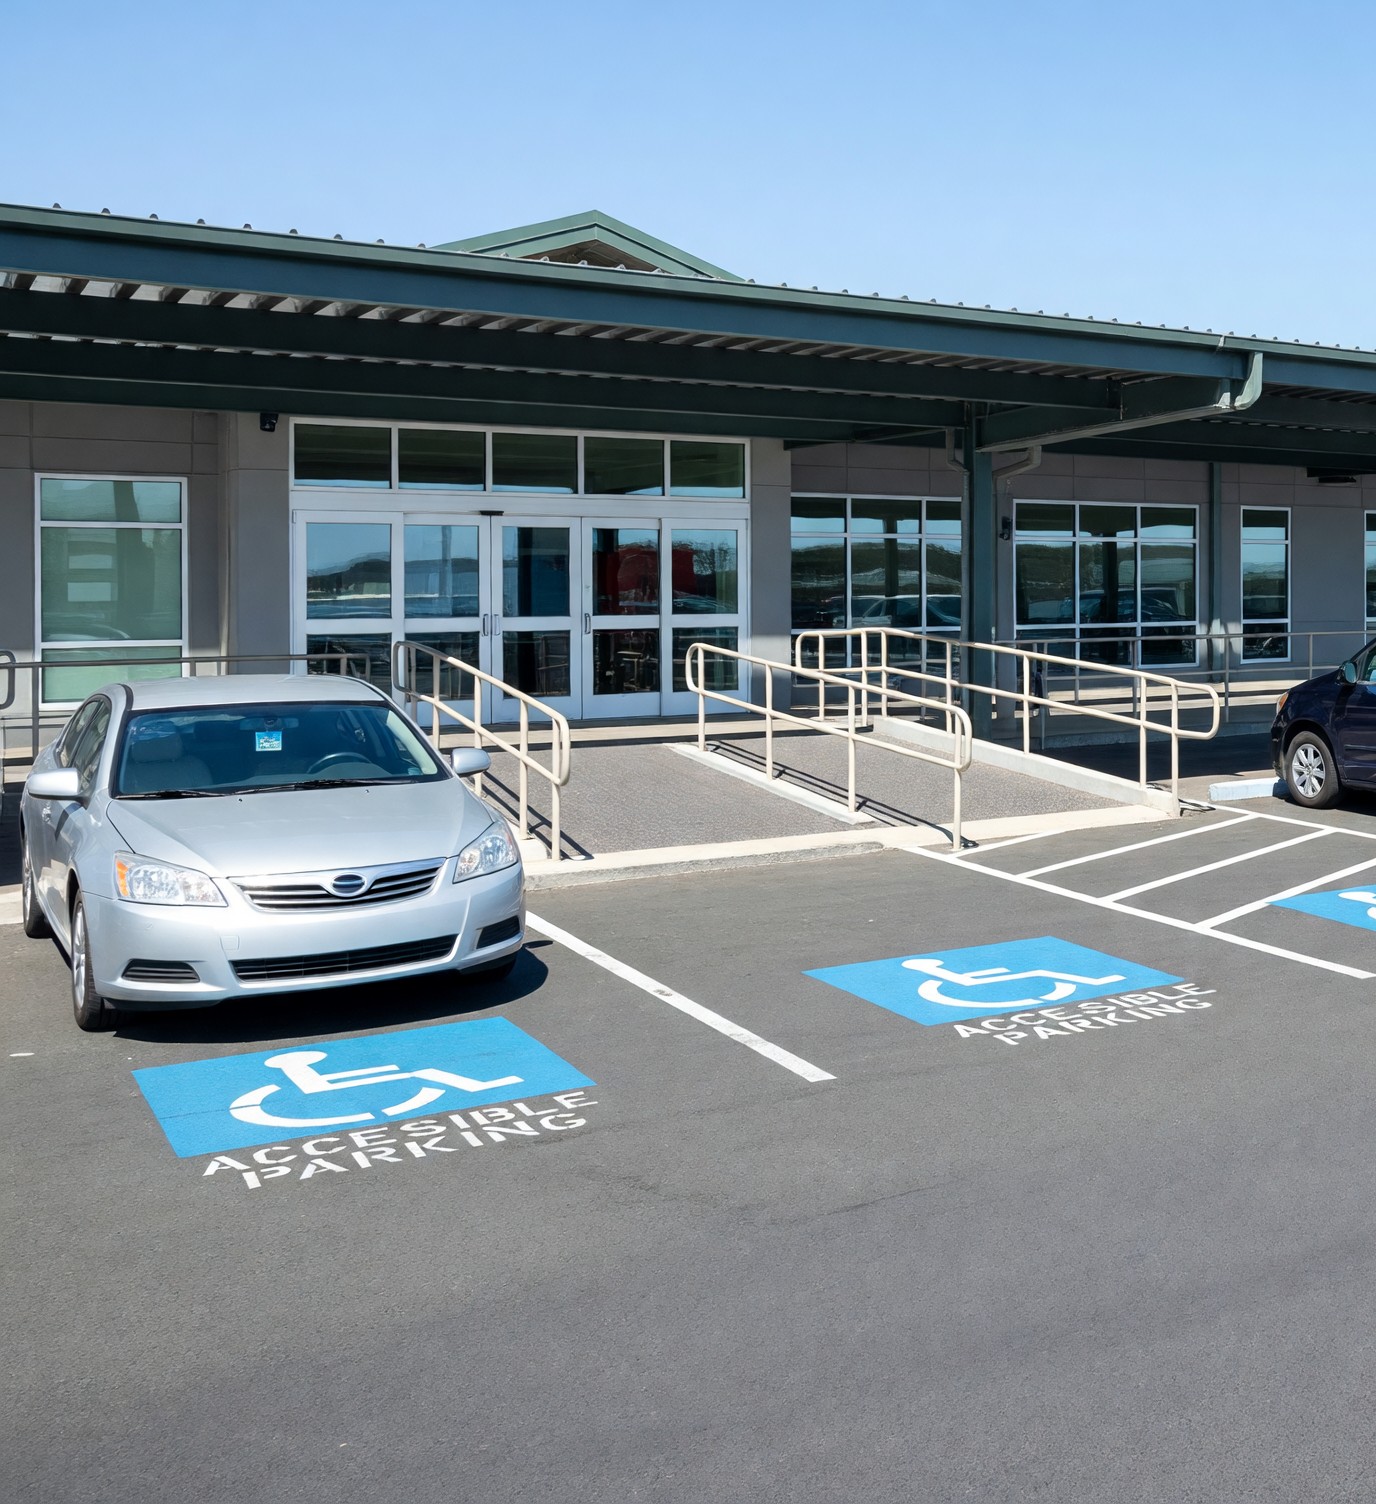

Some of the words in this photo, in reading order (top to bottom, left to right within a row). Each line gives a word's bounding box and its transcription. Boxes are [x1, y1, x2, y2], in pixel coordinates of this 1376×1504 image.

[953, 983, 1217, 1038] ACCESIBLE
[993, 999, 1212, 1045] PARKING
[202, 1091, 598, 1177] ACCESIBLE
[243, 1113, 586, 1190] PARKING
